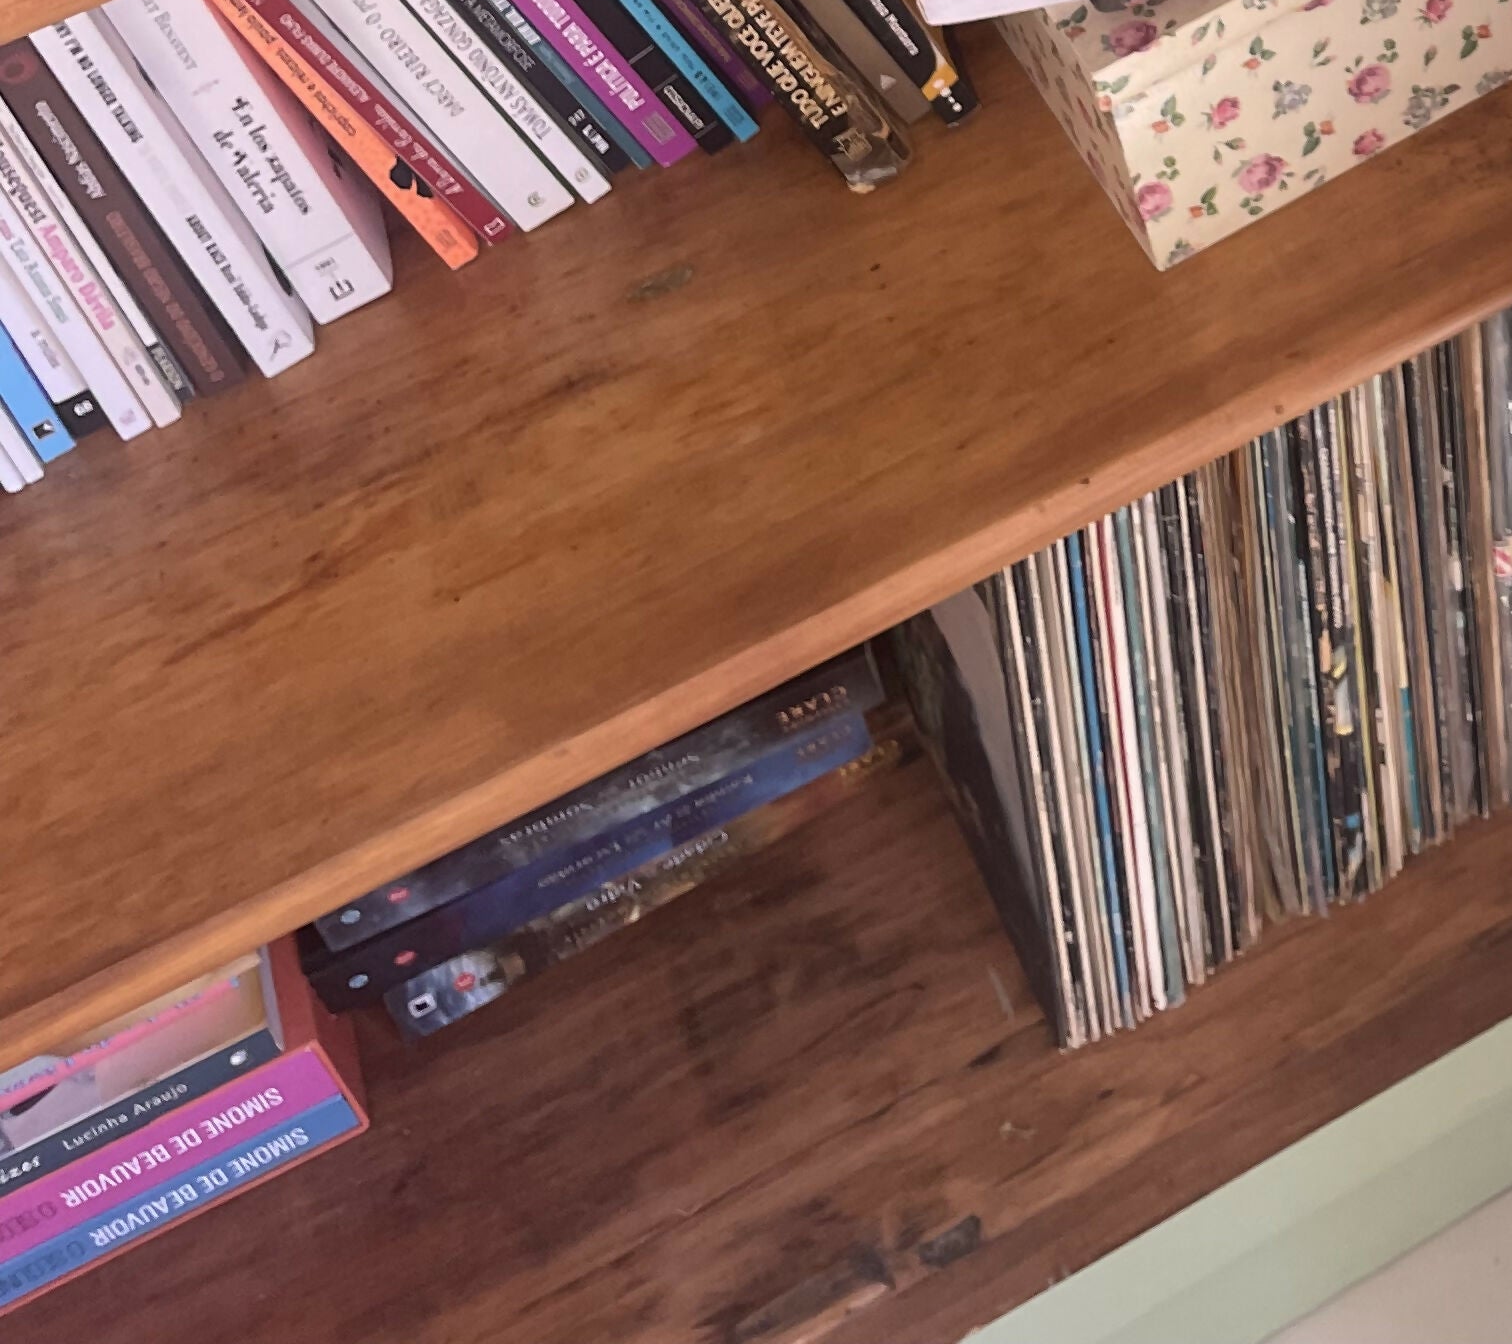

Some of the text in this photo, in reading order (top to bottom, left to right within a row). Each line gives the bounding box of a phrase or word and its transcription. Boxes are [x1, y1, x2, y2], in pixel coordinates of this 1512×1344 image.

[363, 9, 383, 29] O
[560, 19, 598, 59] PARA
[753, 6, 790, 48] TEVE
[300, 32, 333, 66] DUMAS
[377, 24, 431, 82] RIBEIRO
[583, 48, 605, 69] É
[735, 21, 777, 68] VOCE
[85, 67, 118, 108] LONGER
[421, 73, 465, 120] DARCY
[463, 44, 519, 103] ANTÔNIO
[589, 55, 646, 116] POLÍTICA
[764, 56, 800, 95] QUE
[505, 92, 553, 143] TOMÁS
[788, 84, 830, 131] TUDO
[829, 100, 848, 118] E
[212, 125, 280, 216] de Valeria
[227, 92, 313, 221] En los zapatos
[0, 144, 49, 227] ouseguest
[35, 218, 89, 287] Amparo
[76, 279, 120, 332] Dávila
[60, 1107, 130, 1154] Lucinha
[129, 1077, 190, 1119] Araujo
[199, 1083, 285, 1140] SIMONE
[167, 1124, 202, 1155] DE
[227, 1123, 310, 1179] SIMONE
[58, 1140, 171, 1211] BEAUVOIR
[195, 1164, 229, 1194] DE
[87, 1180, 198, 1249] BEAUVOIR
